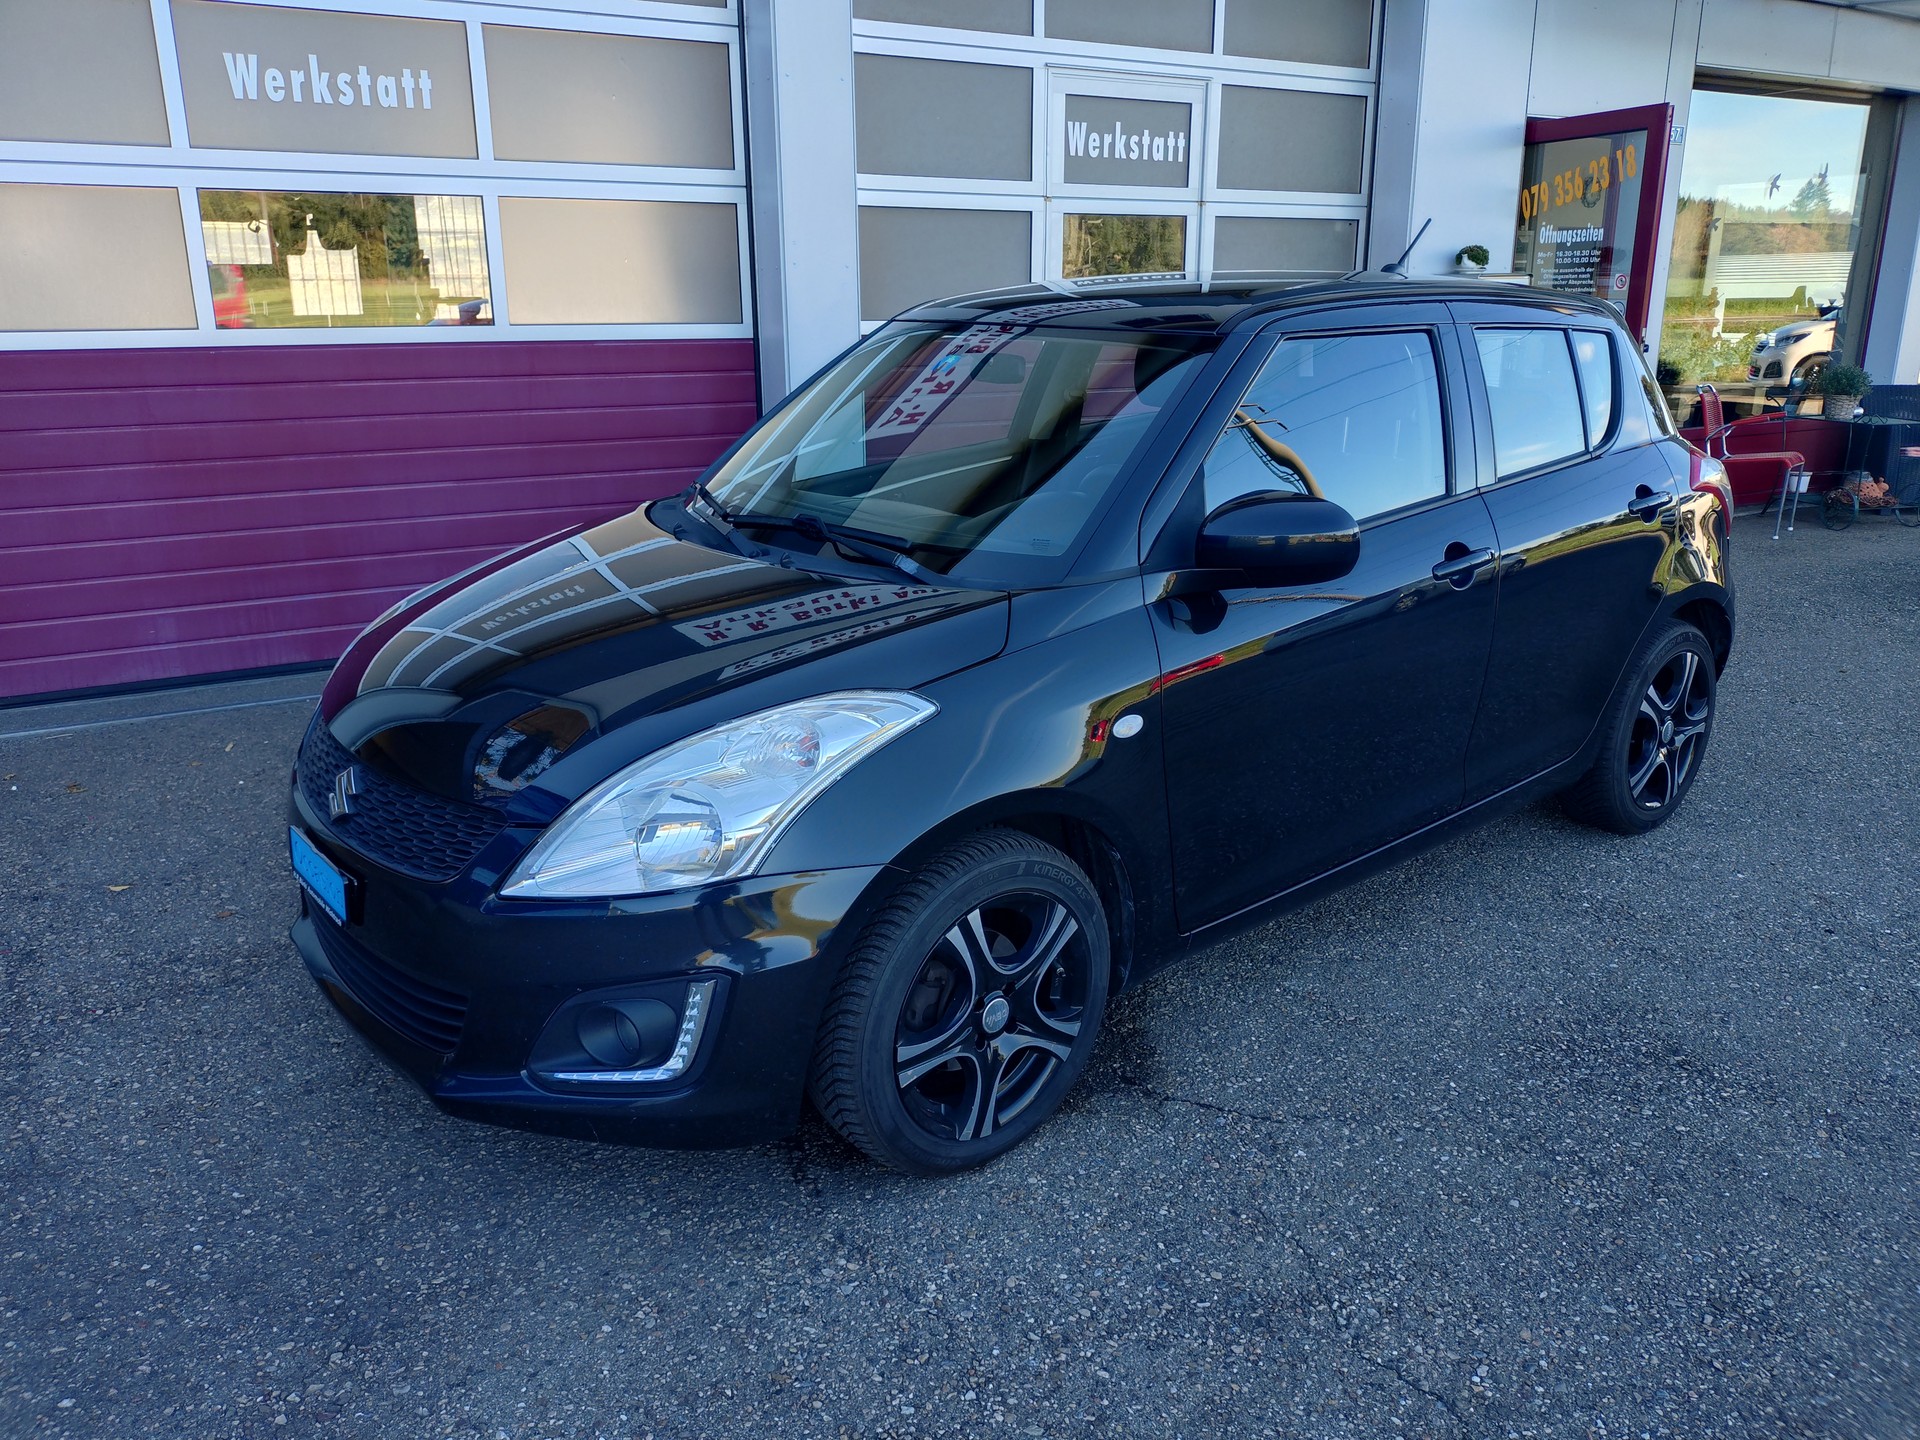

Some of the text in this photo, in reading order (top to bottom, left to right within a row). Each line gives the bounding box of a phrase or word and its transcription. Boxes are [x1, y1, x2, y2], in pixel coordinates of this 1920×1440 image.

[222, 52, 432, 109] Werkstatt
[1067, 121, 1186, 163] Werkstatt
[1521, 144, 1637, 220] 079 356 23 18
[1539, 221, 1604, 246] Öffnungszeiten
[1033, 864, 1078, 888] KINERGY
